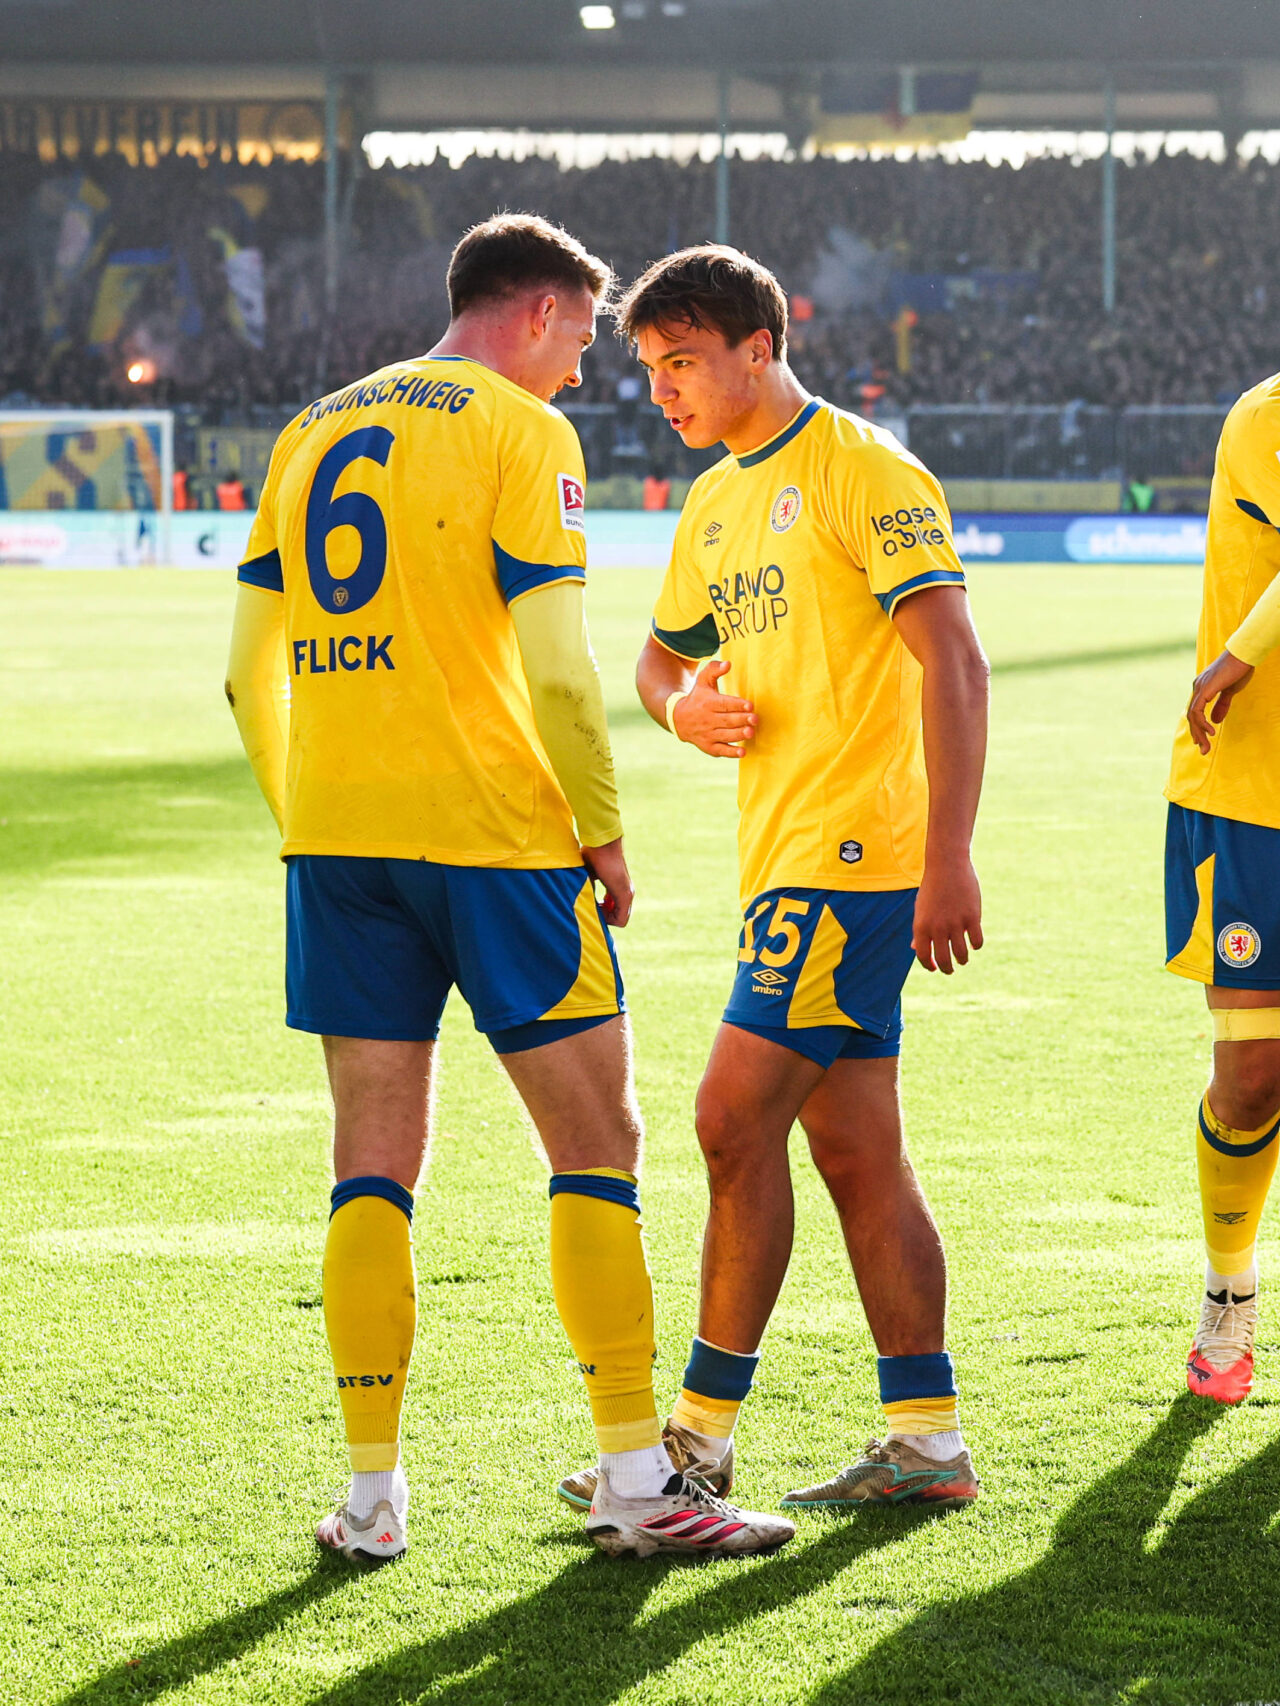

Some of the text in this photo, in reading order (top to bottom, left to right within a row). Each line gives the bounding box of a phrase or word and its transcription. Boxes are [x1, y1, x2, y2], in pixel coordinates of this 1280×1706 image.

[300, 376, 475, 429] BRAUNSCHWEIG
[305, 425, 395, 615] 6
[871, 507, 936, 536] lease
[293, 634, 395, 675] FLICK
[738, 896, 810, 968] 15
[752, 984, 783, 996] umbro
[337, 1374, 394, 1389] BTSV
